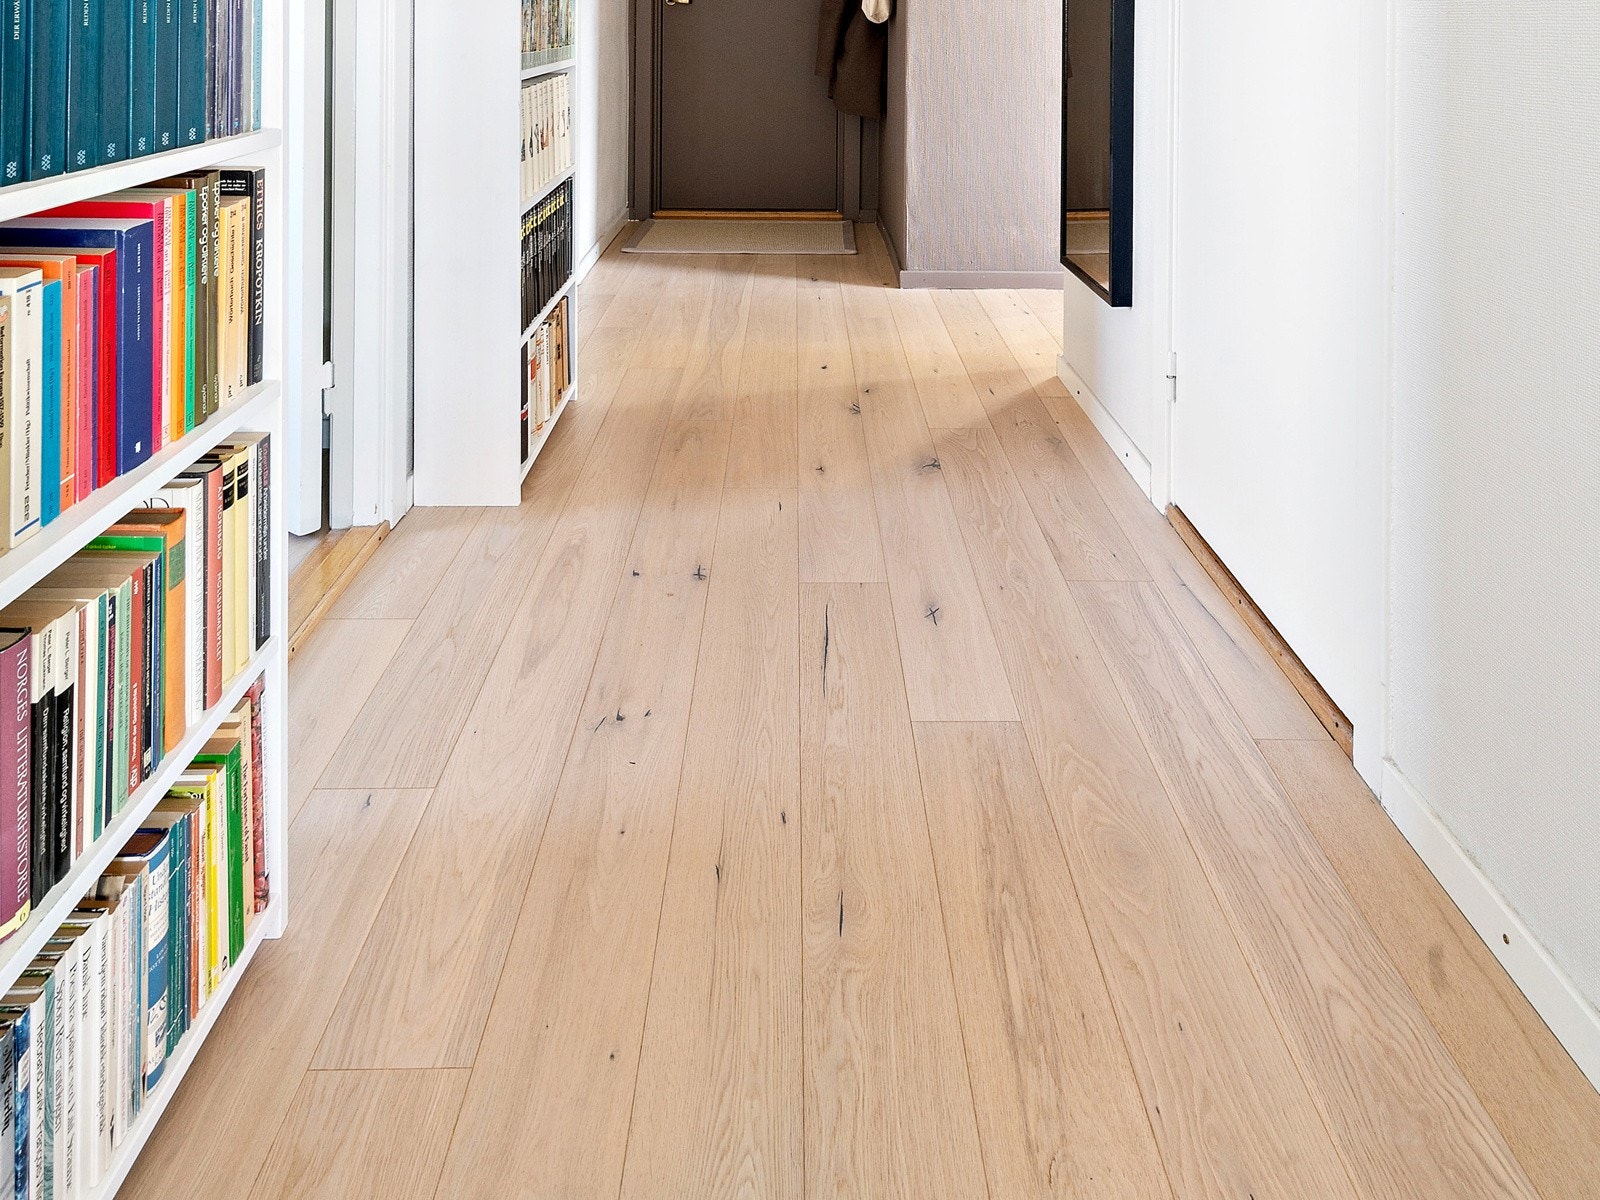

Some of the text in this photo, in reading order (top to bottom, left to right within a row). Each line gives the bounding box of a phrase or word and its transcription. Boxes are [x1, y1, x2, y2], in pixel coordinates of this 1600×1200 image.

[200, 185, 208, 226] Epoker
[199, 227, 206, 244] og
[211, 221, 218, 237] og
[60, 707, 69, 750] Religion,
[15, 647, 29, 903] NORGES LITTERATURHISTORIE
[60, 788, 66, 804] og
[59, 801, 67, 853] virkelighed
[244, 824, 248, 836] of
[69, 961, 77, 1001] Poesi
[82, 945, 91, 990] Dansk
[54, 978, 64, 1027] Spoon
[1, 1041, 12, 1084] Nils
[36, 1019, 44, 1082] Herbrand
[55, 1024, 64, 1063] River
[34, 1119, 43, 1180] François
